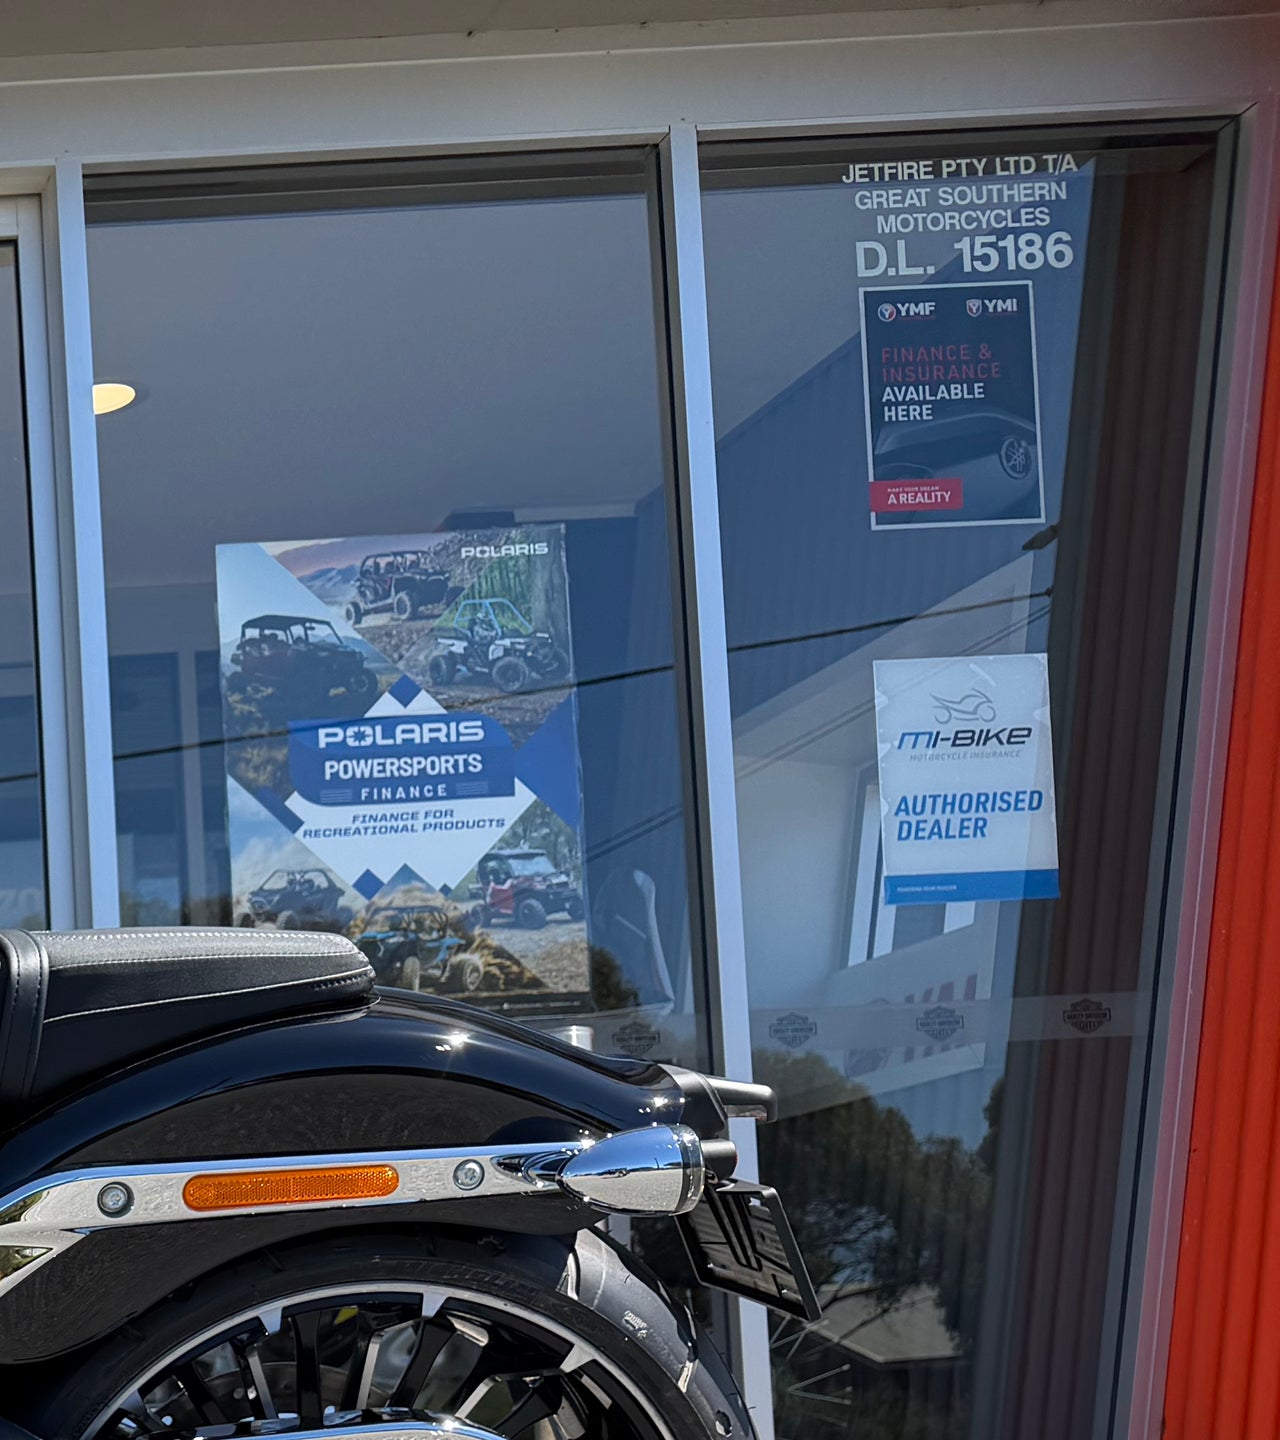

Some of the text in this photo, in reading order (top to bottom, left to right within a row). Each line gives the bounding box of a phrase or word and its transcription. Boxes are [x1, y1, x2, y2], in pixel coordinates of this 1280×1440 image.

[842, 153, 1079, 185] JETFIRE PTY LTD T/A
[854, 181, 1068, 211] GREAT SOUTHERN
[876, 206, 1051, 234] MOTORCYCLES
[855, 231, 1074, 278] D.L. 15186
[896, 301, 936, 317] YMF
[983, 298, 1018, 313] YMI
[881, 343, 992, 364] FINANCE &
[882, 362, 1002, 383] INSURANCE
[881, 382, 985, 403] AVAILABLE
[883, 404, 934, 422] HERE
[887, 491, 951, 505] A REALITY
[460, 541, 549, 560] POLARIS
[316, 719, 485, 749] POLARIS
[324, 753, 483, 781] POWERSPORTS
[360, 783, 448, 801] FINANCE
[894, 789, 1044, 817] AUTHORISED
[351, 808, 455, 825] FINANCE FOR
[302, 817, 506, 840] RECREATIONAL PRODUCTS
[896, 816, 988, 842] DEALER
